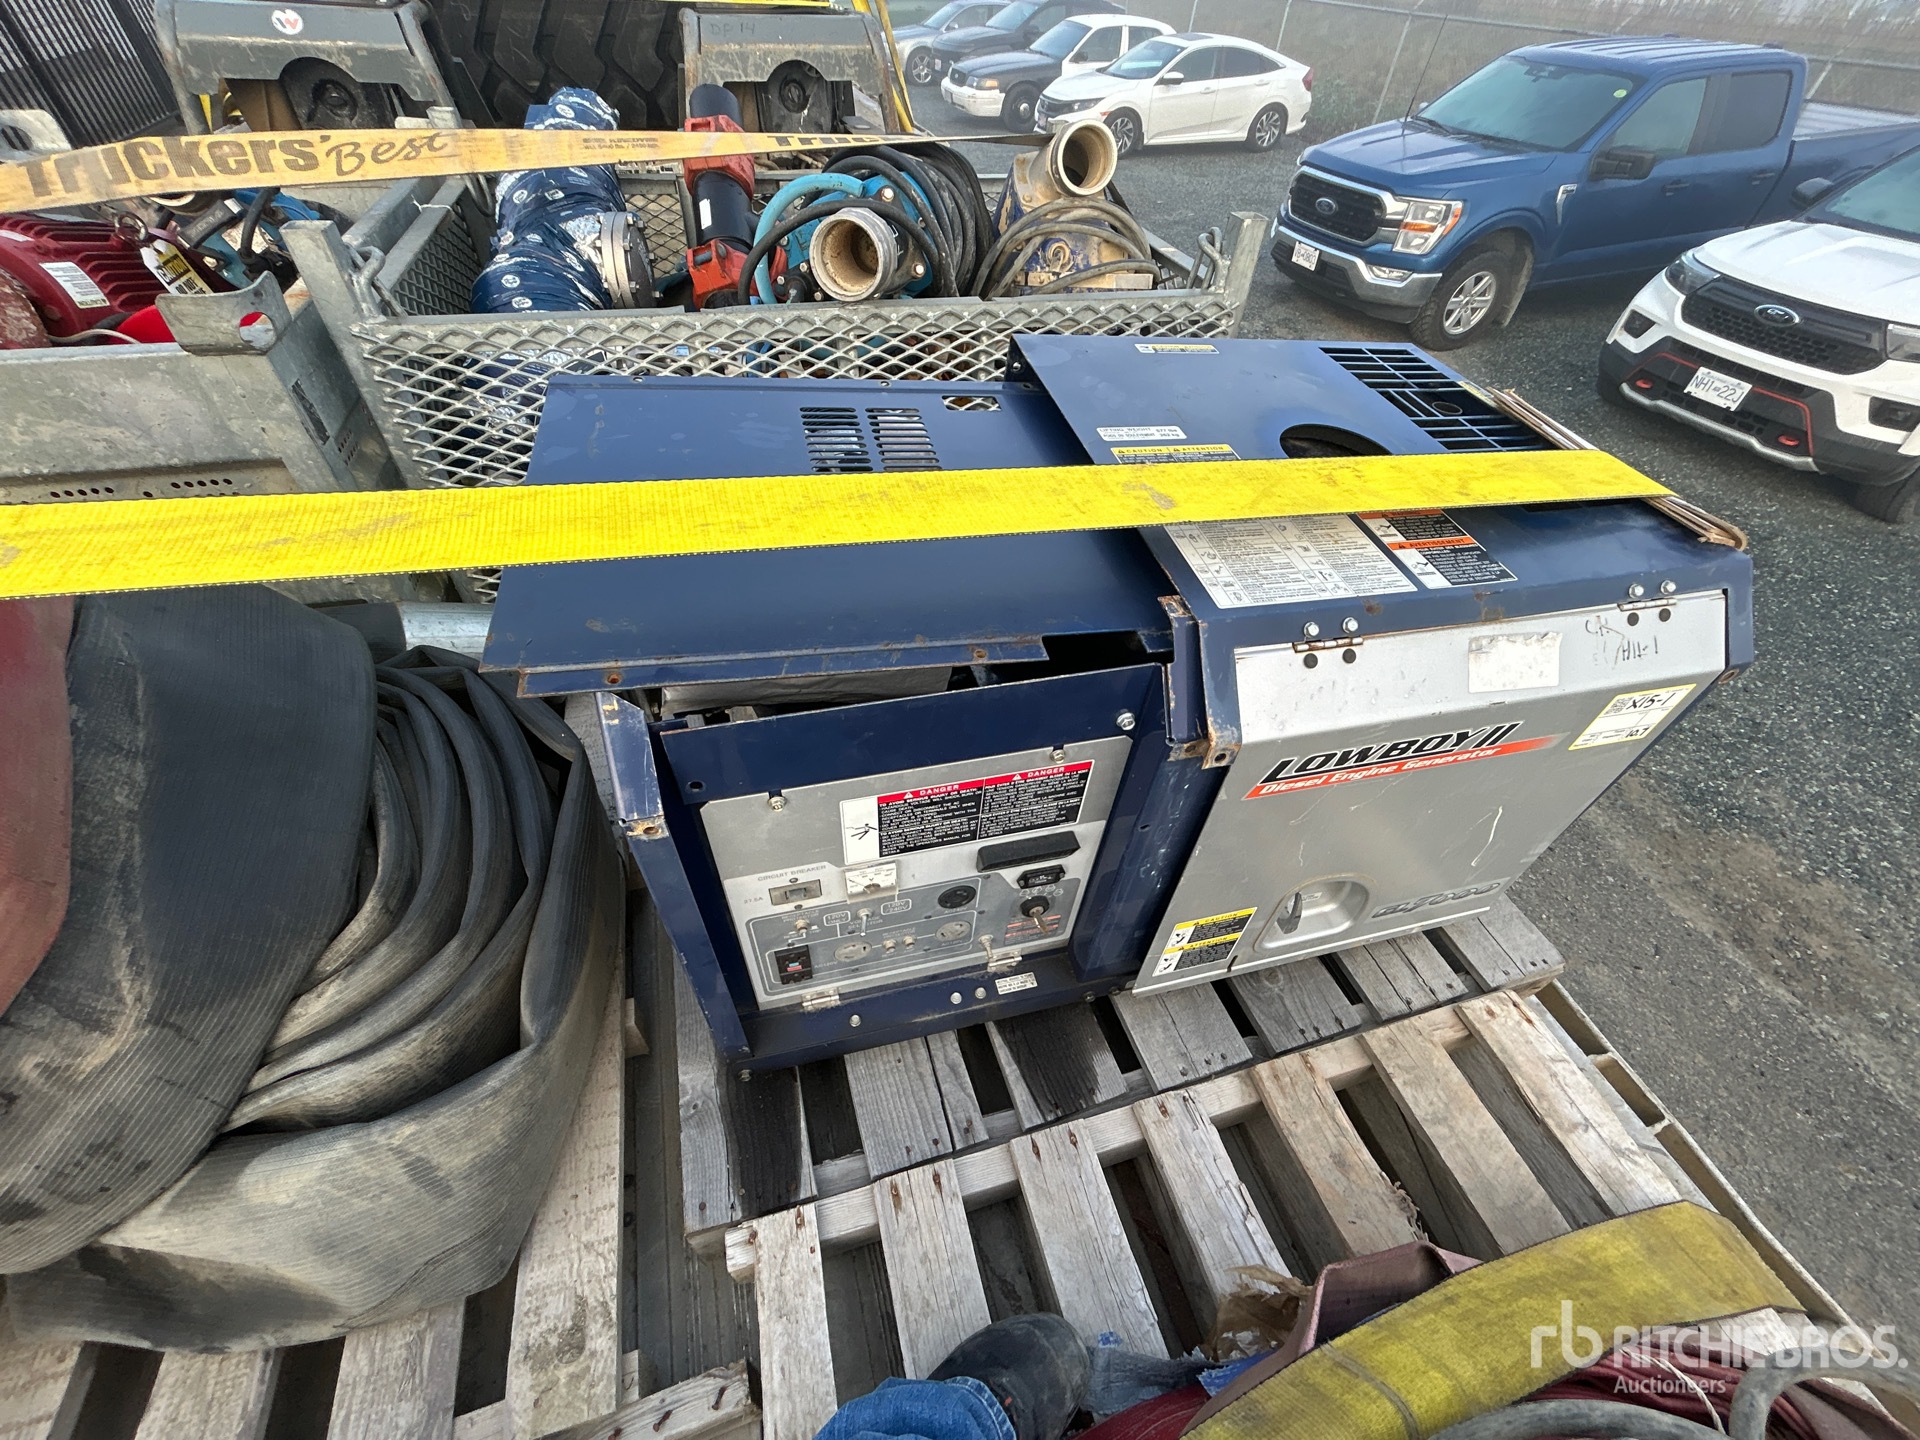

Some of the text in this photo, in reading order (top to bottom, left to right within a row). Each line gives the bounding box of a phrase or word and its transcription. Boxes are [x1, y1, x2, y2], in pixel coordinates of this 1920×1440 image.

[325, 132, 452, 177] Best
[1690, 375, 1714, 392] NH1
[1717, 385, 1744, 402] 22J
[1409, 538, 1466, 548] AVERTISSEMENT
[1028, 767, 1065, 778] DANGER
[1259, 748, 1502, 795] Diesel Engine Generator
[920, 784, 960, 796] DANGER
[758, 865, 826, 882] CIRCUIT BREAKER
